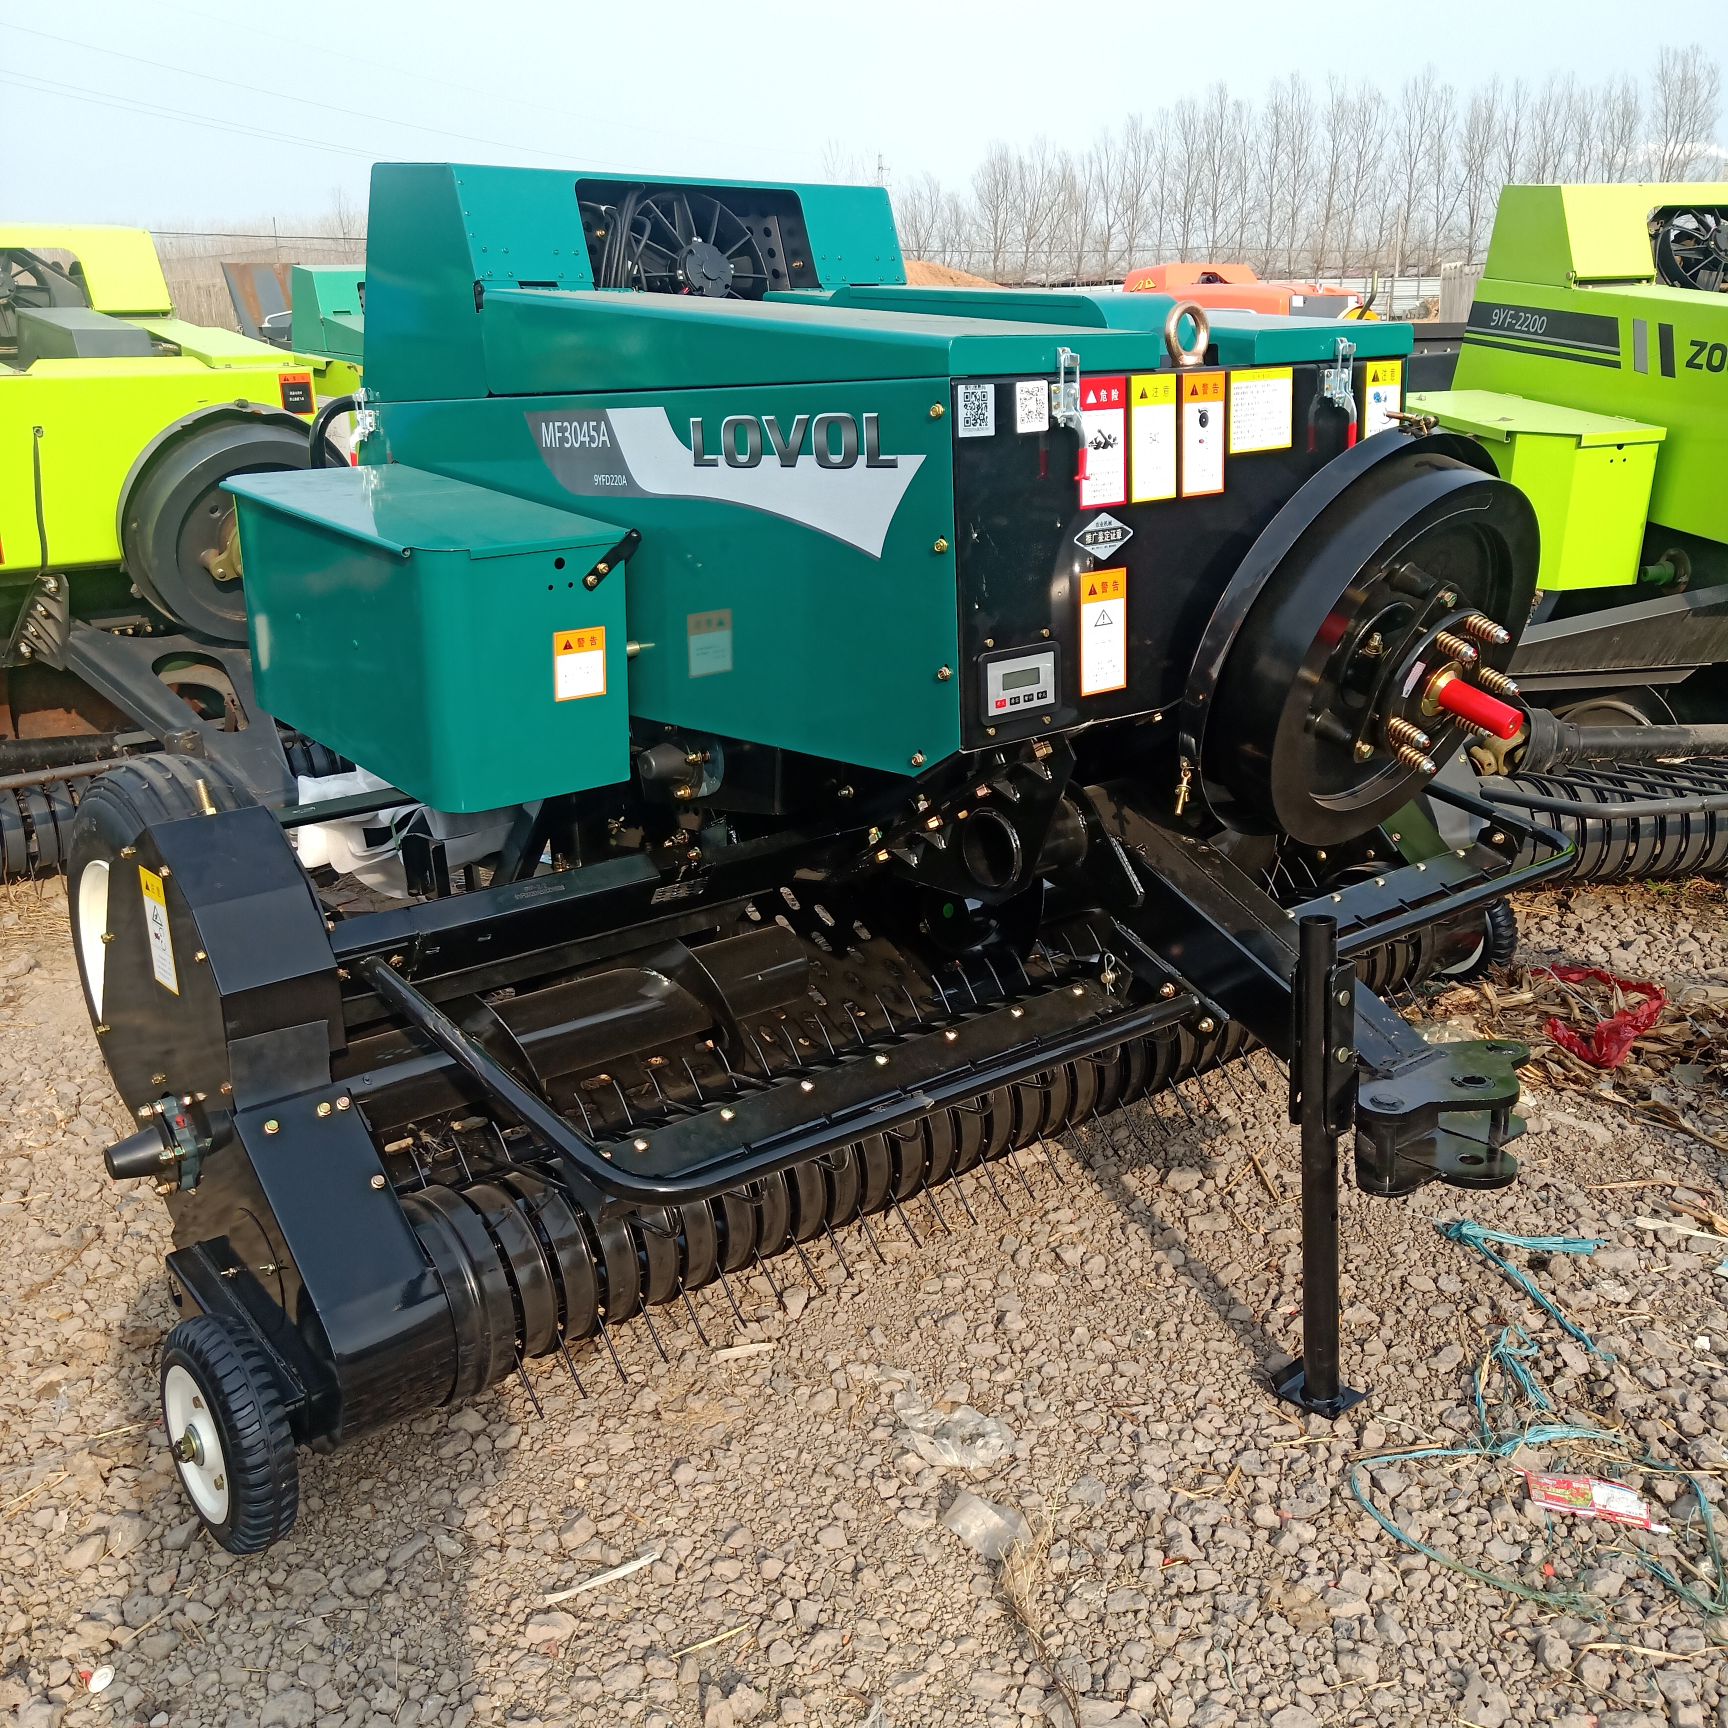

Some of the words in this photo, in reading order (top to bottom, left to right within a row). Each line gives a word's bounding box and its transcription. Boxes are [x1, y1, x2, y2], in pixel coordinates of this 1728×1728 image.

[1490, 308, 1548, 335] 9YF-2200
[1685, 339, 1728, 373] ZO
[1100, 388, 1120, 402] 危险
[1201, 382, 1220, 396] 警告
[541, 420, 611, 448] MF3045A
[689, 412, 899, 469] LOVOL
[593, 474, 628, 487] 9YFD220A
[1101, 580, 1119, 594] 警告
[577, 635, 597, 648] 警告
